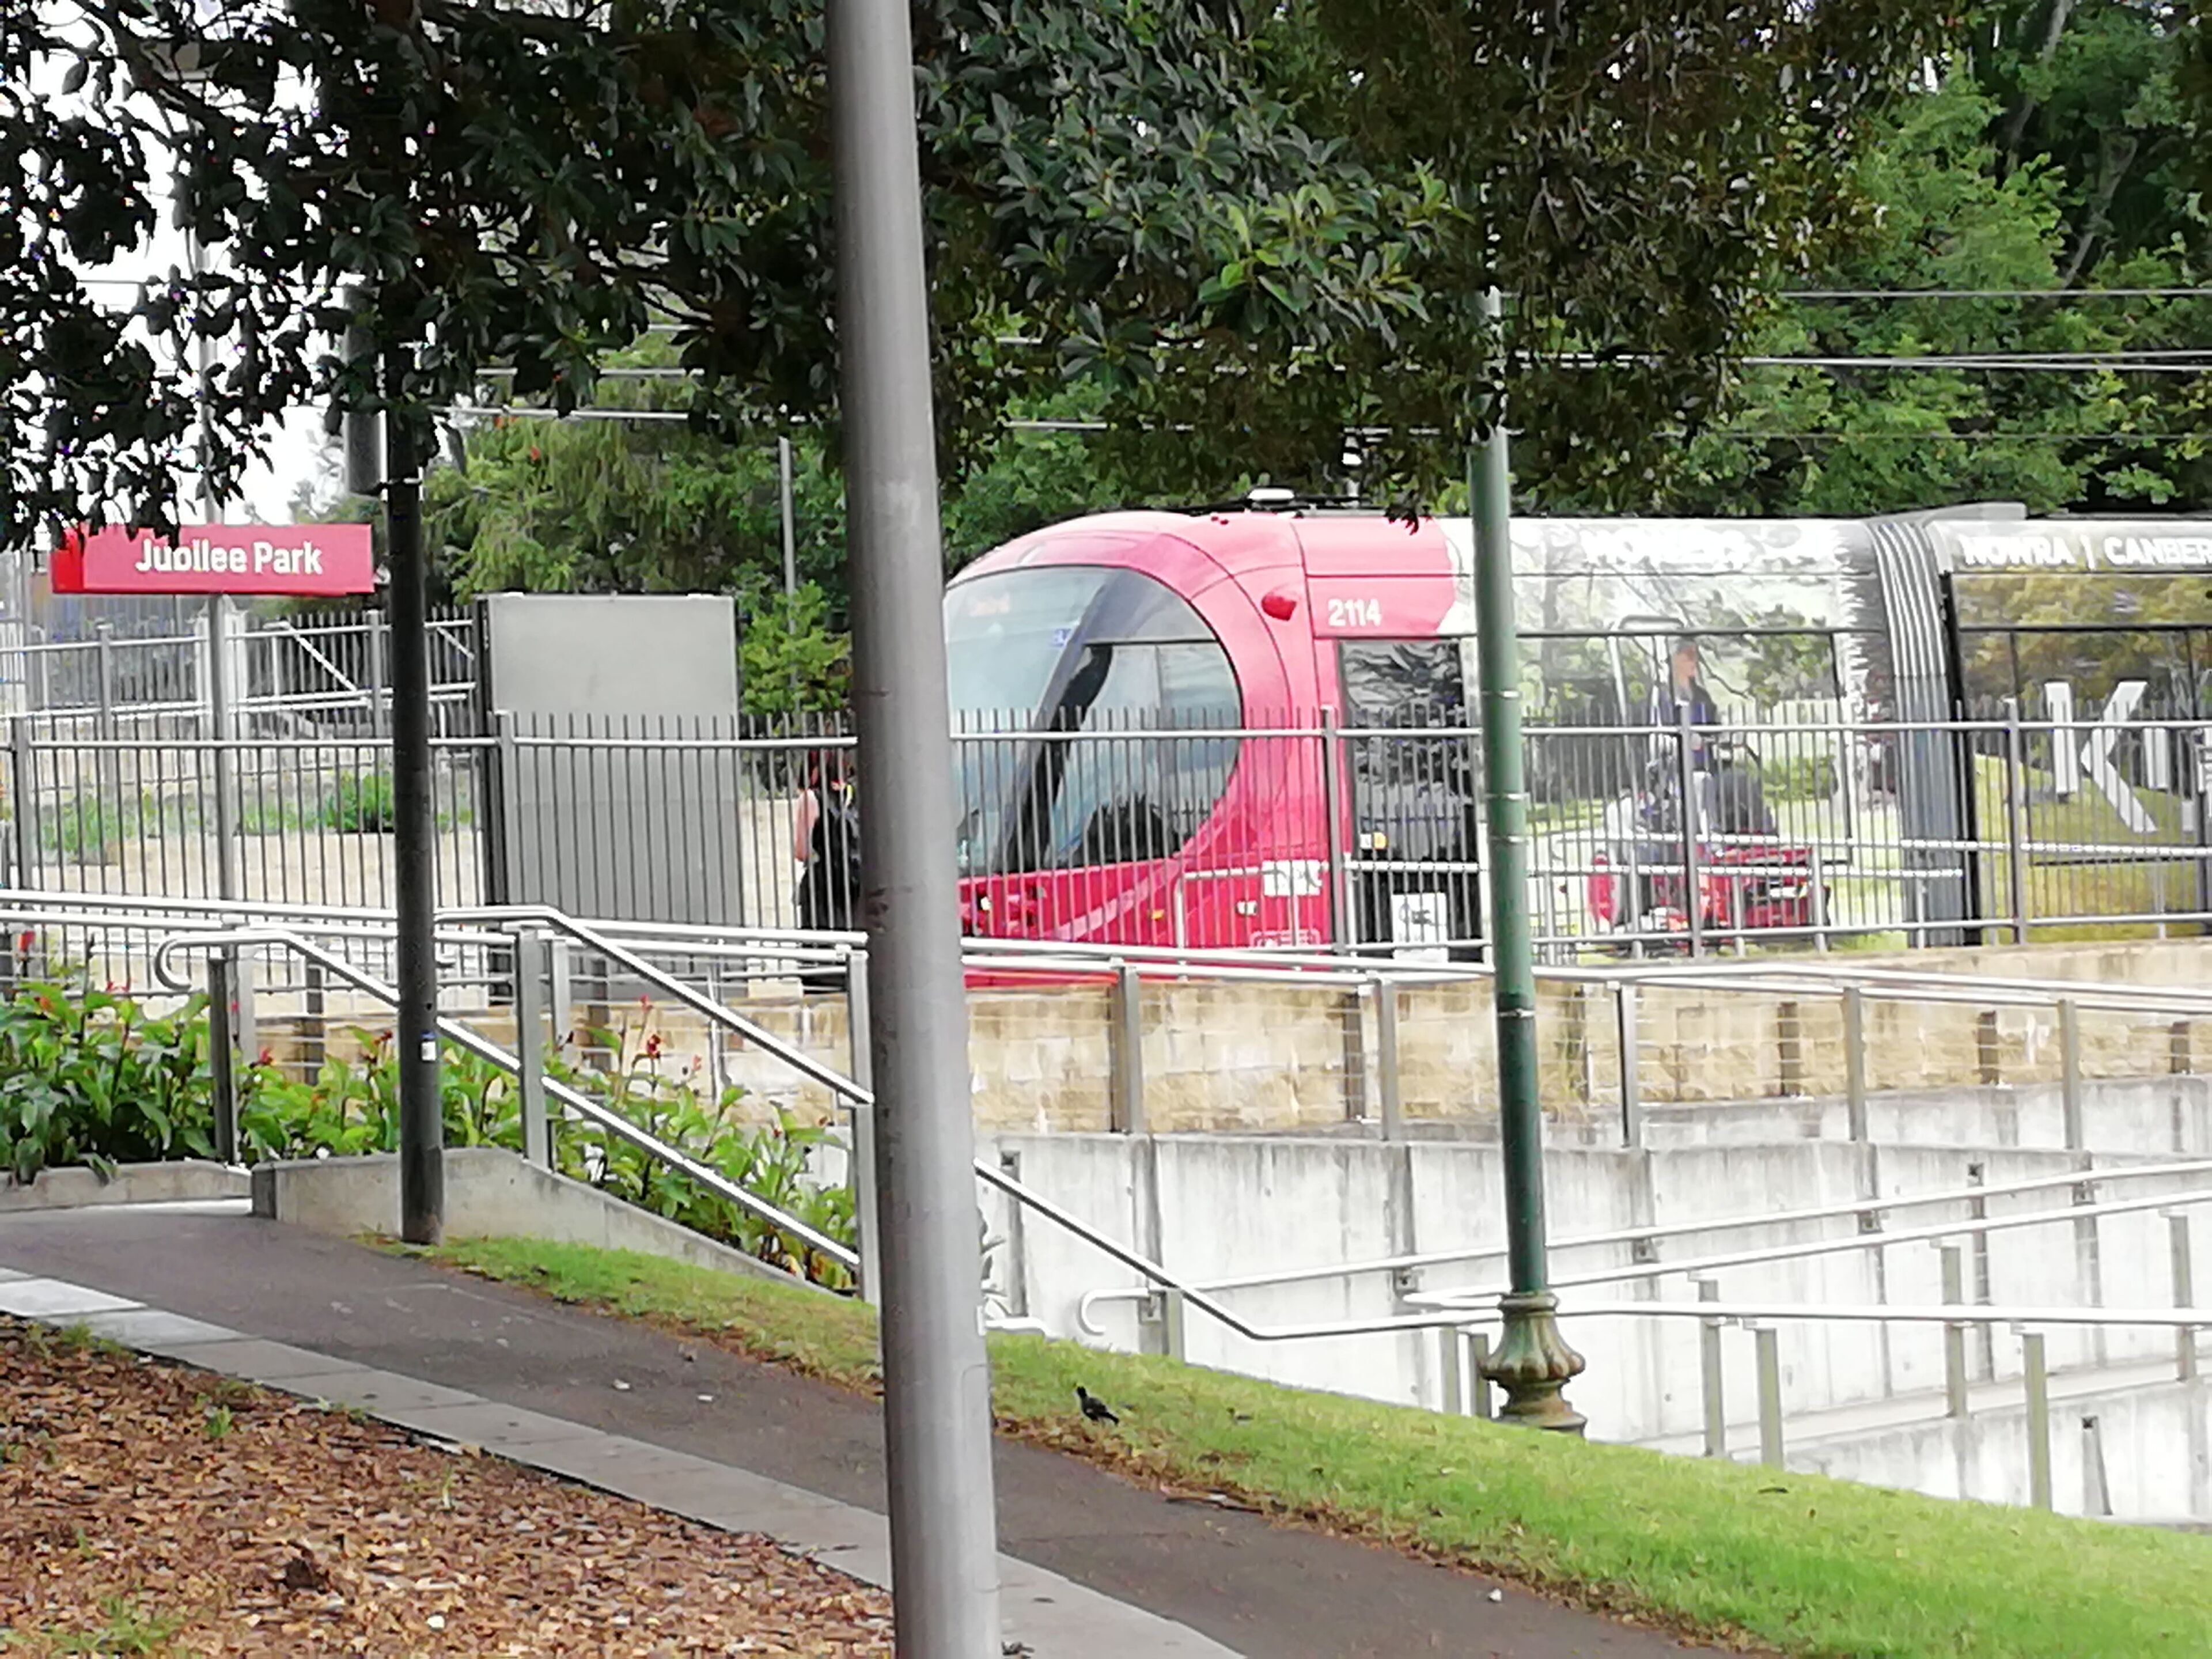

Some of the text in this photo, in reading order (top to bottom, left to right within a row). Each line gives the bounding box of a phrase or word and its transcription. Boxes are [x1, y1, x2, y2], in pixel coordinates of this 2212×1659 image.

[135, 537, 323, 574] Jubilee Park
[1959, 535, 2077, 566] NOWRA
[1327, 597, 1382, 627] 2114
